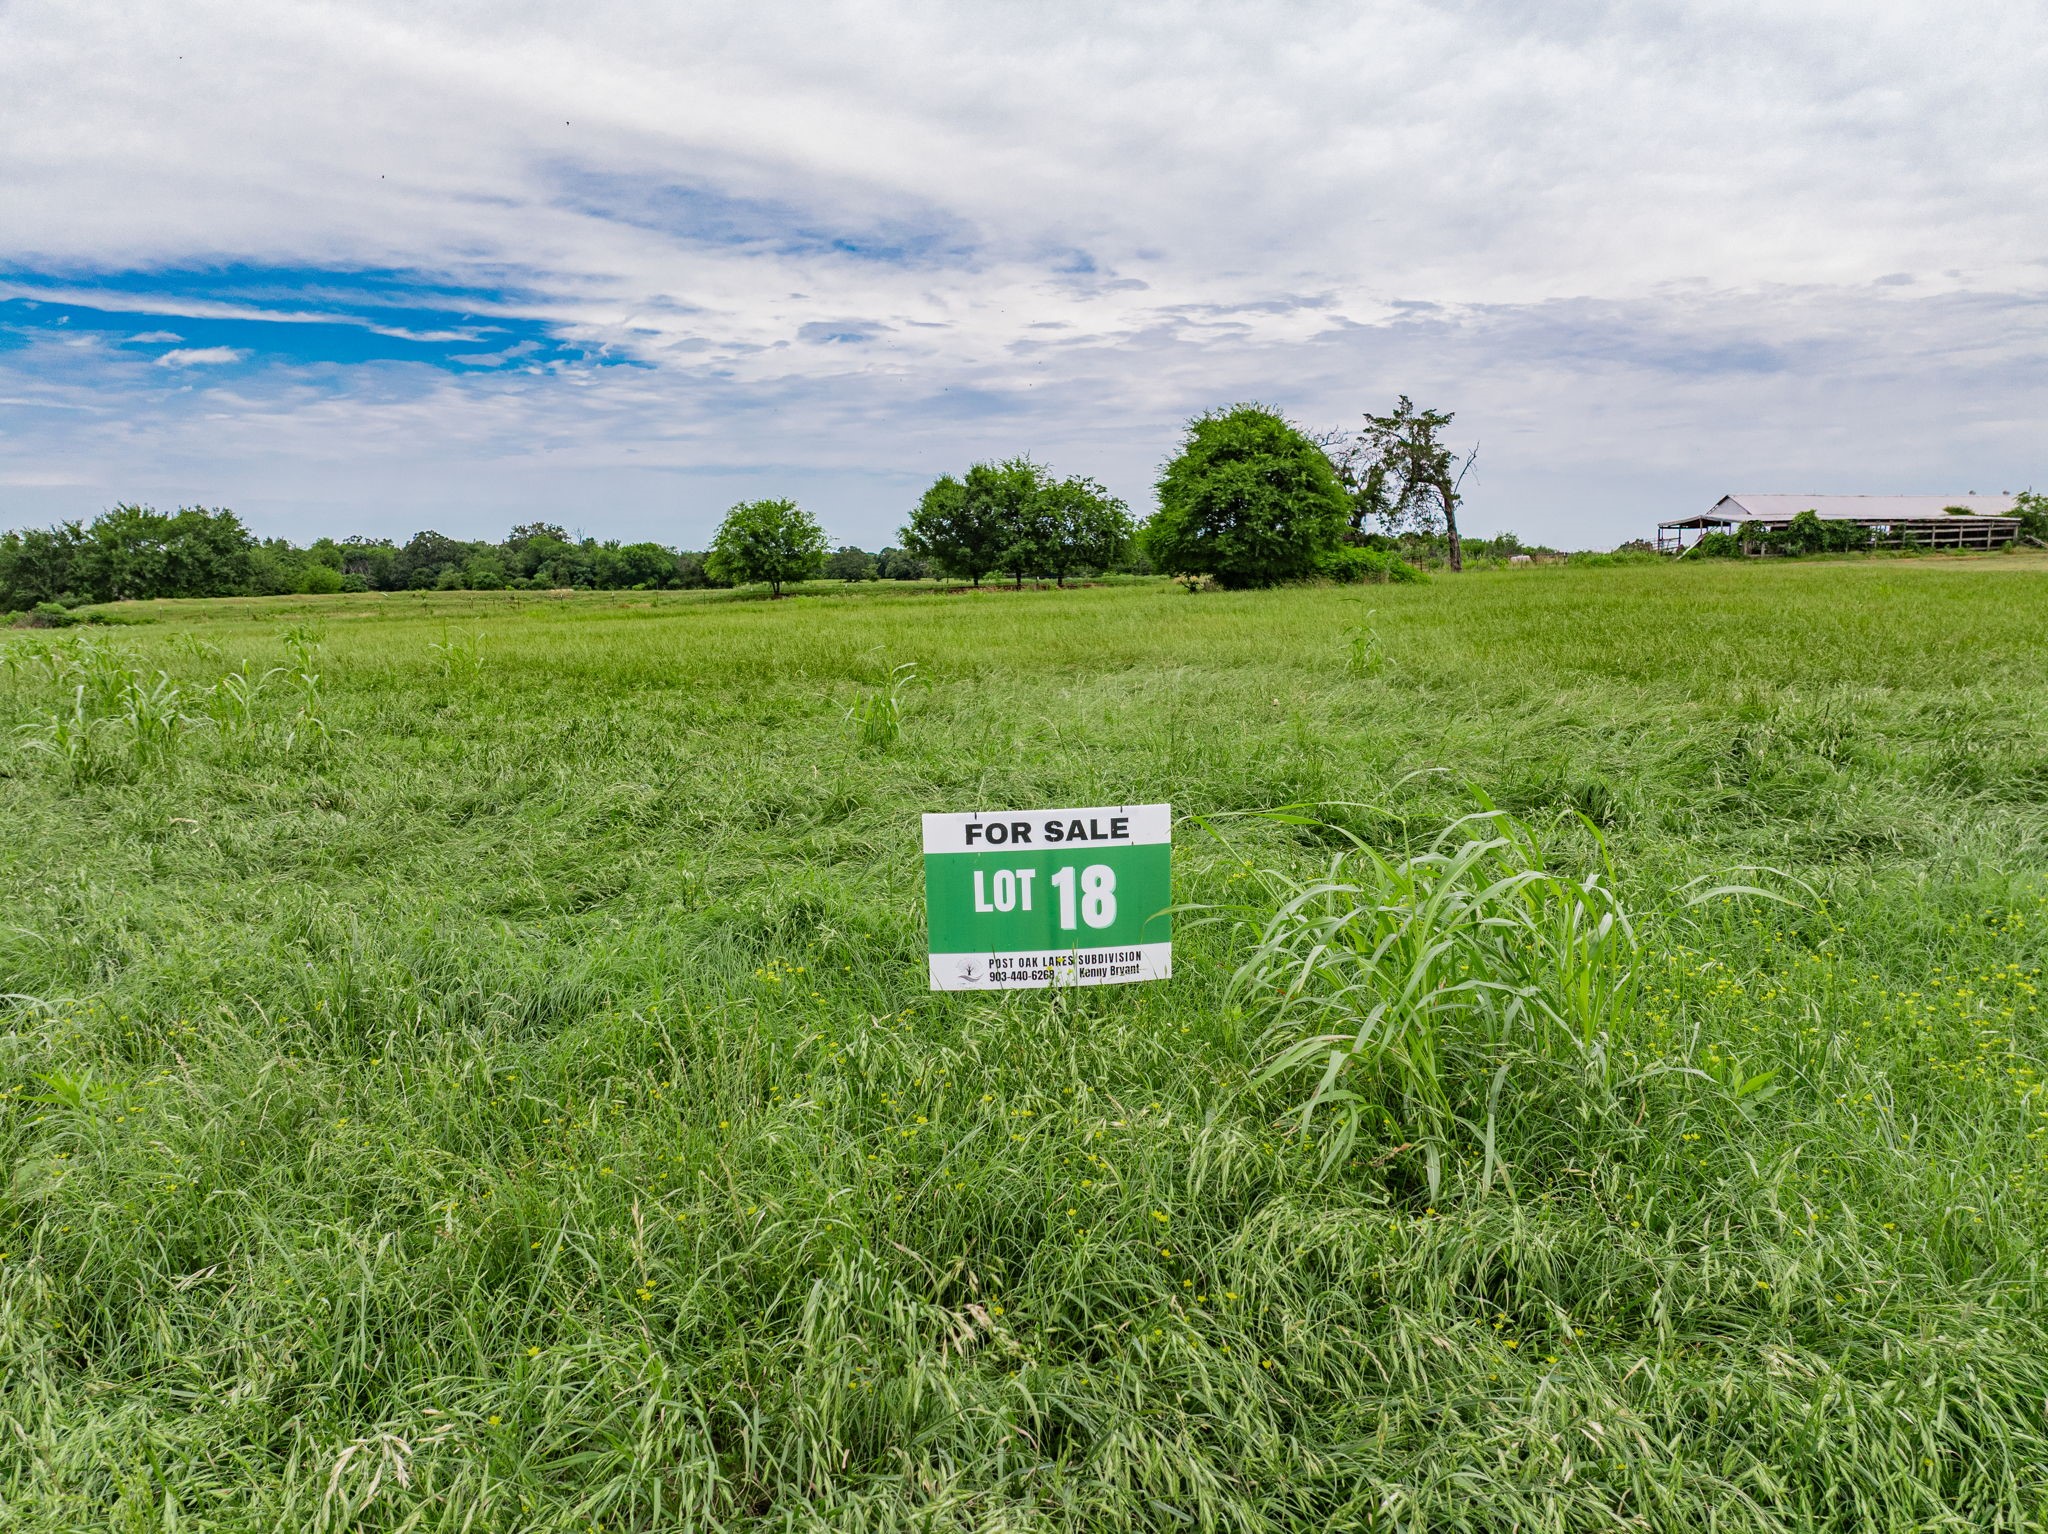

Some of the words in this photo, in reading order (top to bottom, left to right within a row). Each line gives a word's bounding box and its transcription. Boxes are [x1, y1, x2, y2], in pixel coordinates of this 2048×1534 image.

[965, 822, 1032, 845] FOR
[1044, 818, 1129, 842] SALE
[973, 869, 1035, 912] LOT
[1051, 864, 1117, 930] 18
[989, 957, 1013, 969] POST
[1018, 956, 1038, 968] OAK
[1042, 955, 1074, 967] LAKES
[1078, 951, 1142, 965] SUBDIVISION
[1079, 967, 1107, 978] Kenny
[1110, 963, 1140, 976] Bryant
